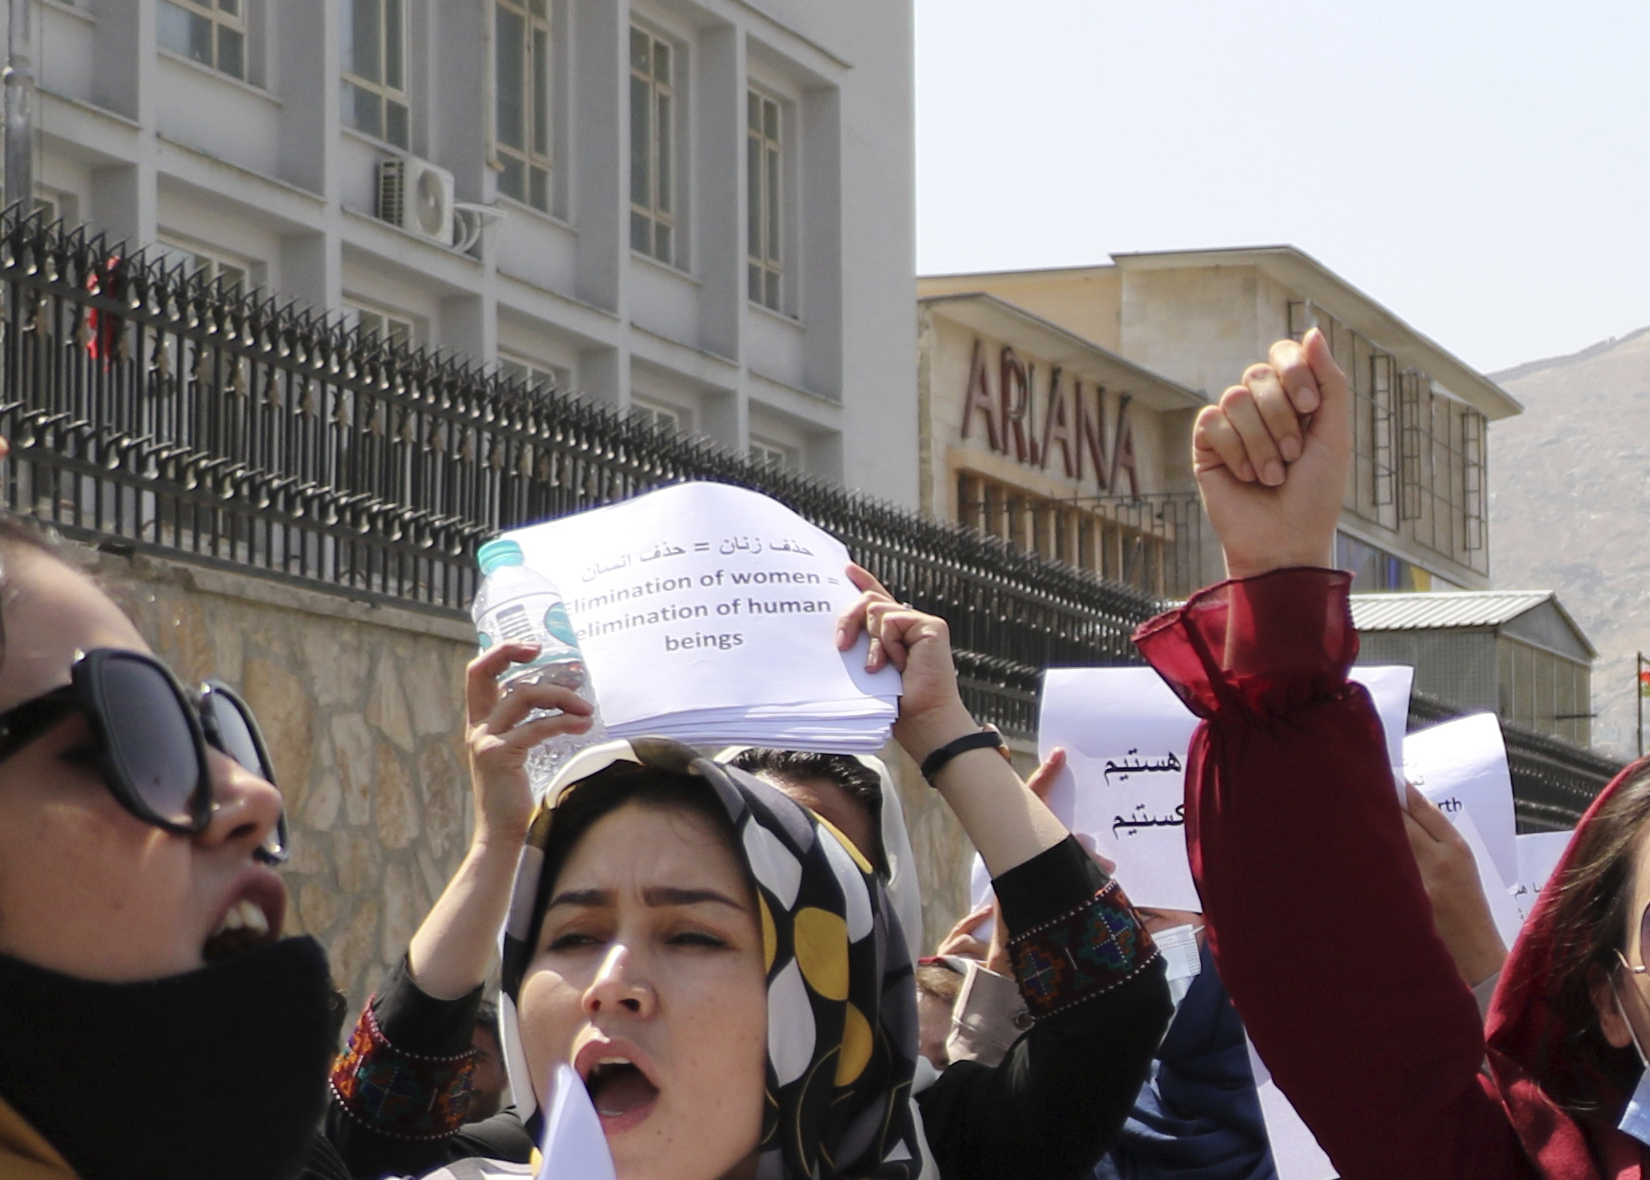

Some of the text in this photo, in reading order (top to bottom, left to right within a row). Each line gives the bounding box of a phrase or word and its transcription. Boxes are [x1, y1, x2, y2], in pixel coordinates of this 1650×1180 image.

[961, 338, 1140, 503] ARIANA
[639, 542, 687, 563] حذف
[718, 538, 763, 555] زنان
[769, 539, 814, 557] حذف
[700, 569, 726, 587] of
[731, 570, 821, 585] women
[576, 597, 831, 641] elimination of human
[664, 630, 744, 652] beings
